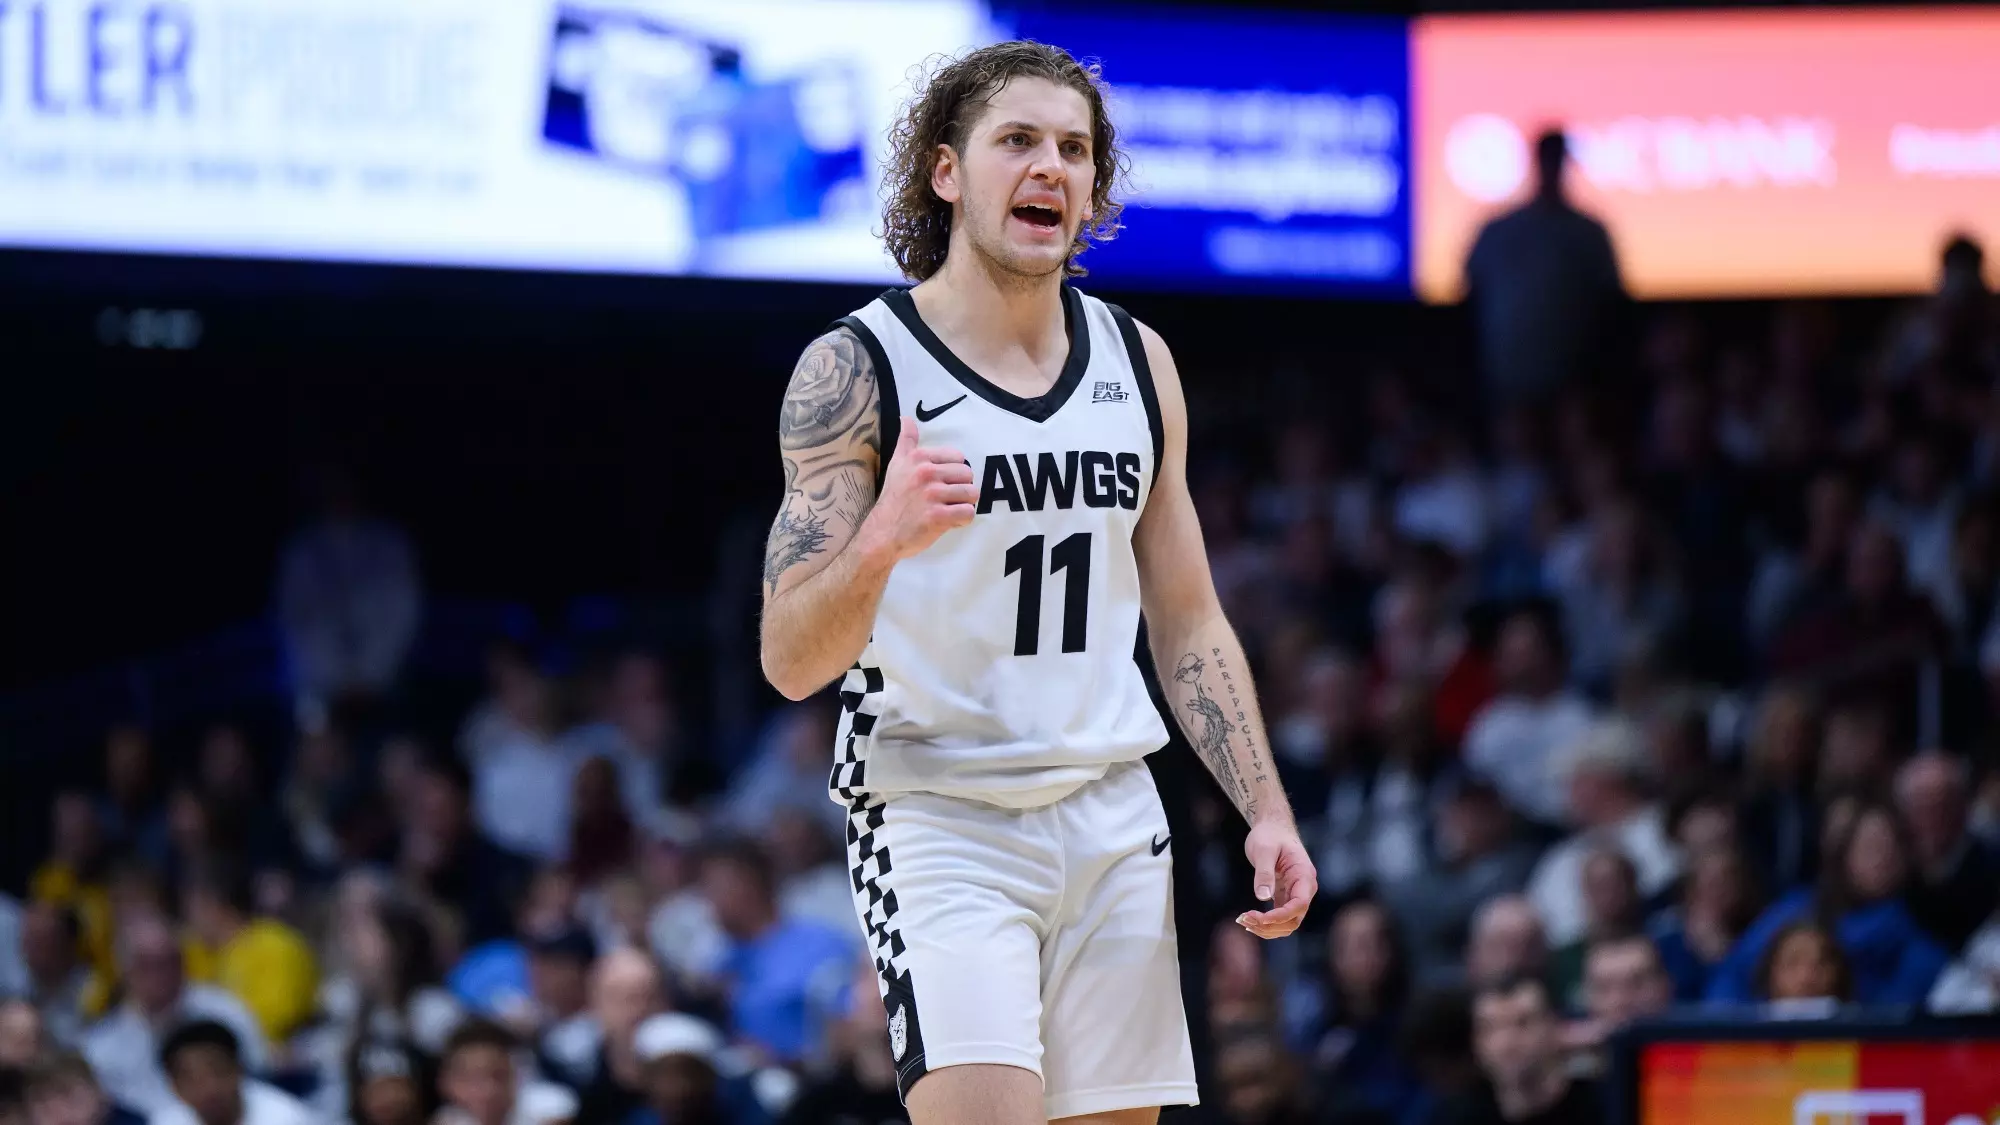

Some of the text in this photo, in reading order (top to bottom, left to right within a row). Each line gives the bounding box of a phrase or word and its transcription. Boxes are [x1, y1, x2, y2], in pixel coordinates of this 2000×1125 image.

[1092, 391, 1130, 400] EAST
[1094, 381, 1121, 391] BIG
[964, 451, 1141, 514] AWGS
[1004, 533, 1092, 656] 11
[1212, 647, 1267, 783] PERSPECTIVE
